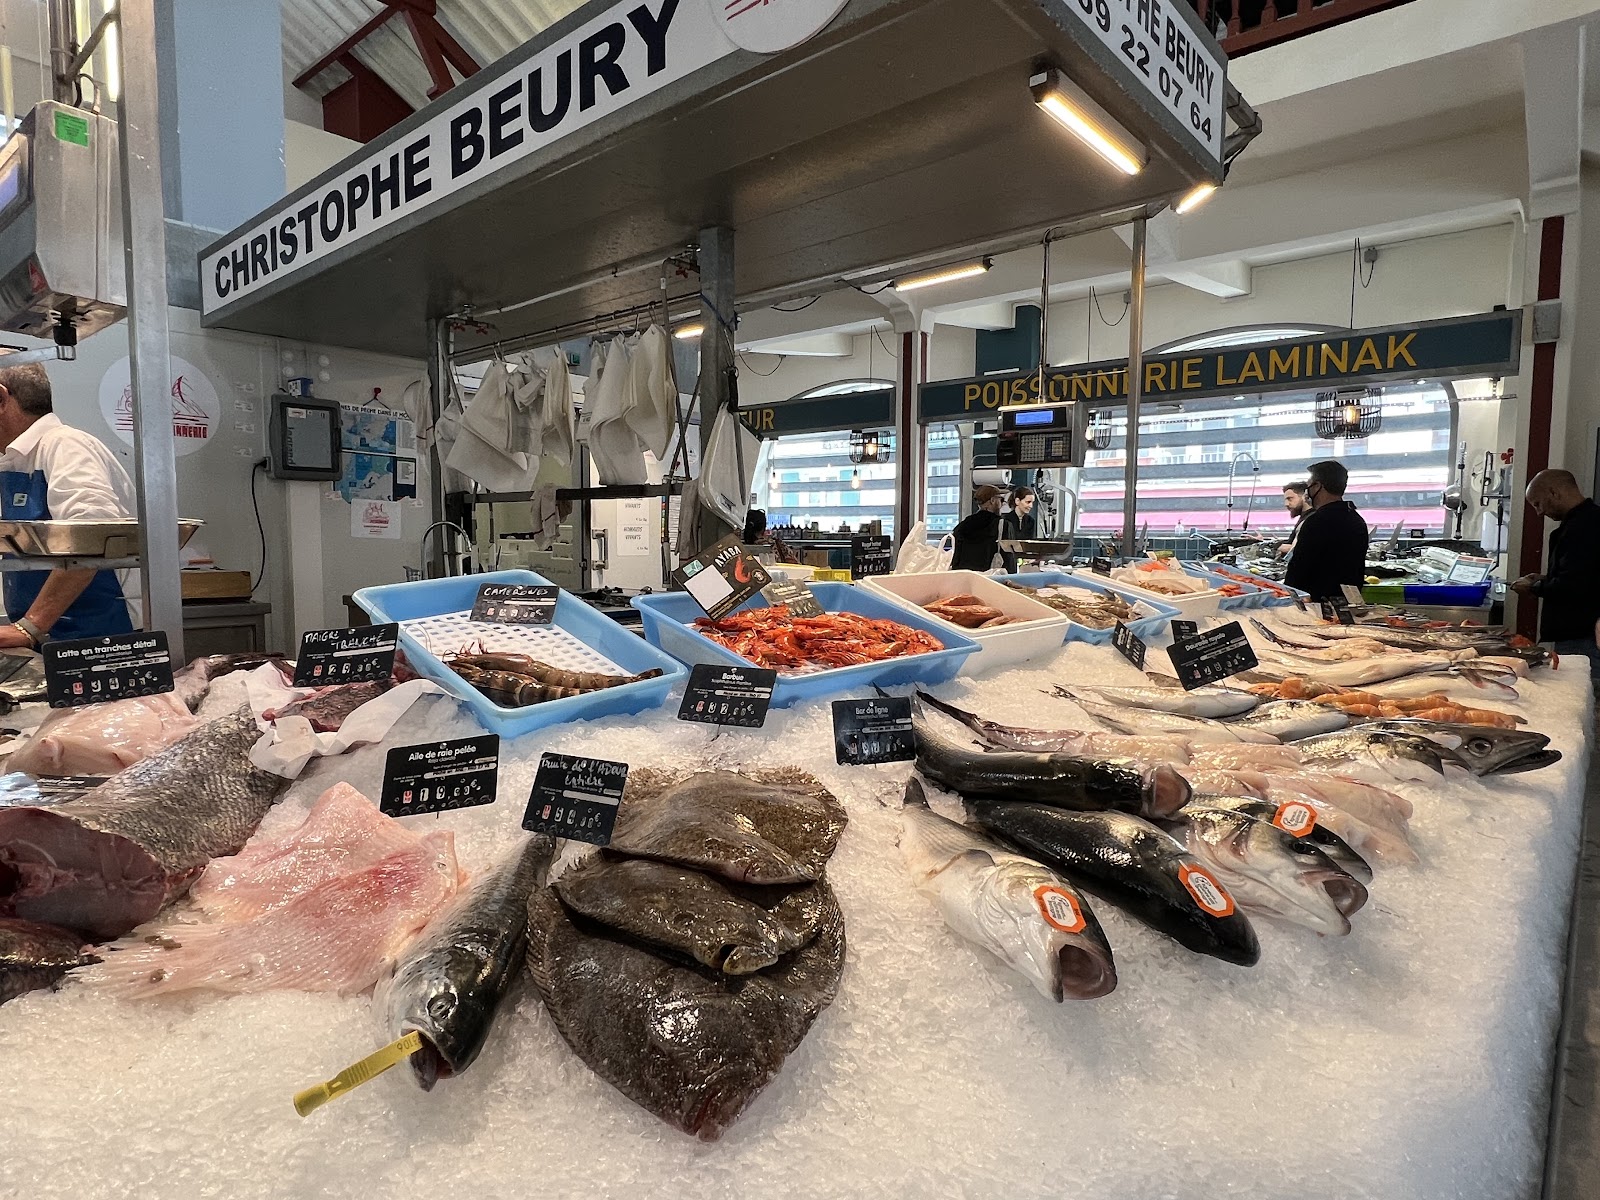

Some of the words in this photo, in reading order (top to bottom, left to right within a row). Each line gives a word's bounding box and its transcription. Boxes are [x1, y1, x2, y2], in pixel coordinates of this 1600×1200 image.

[1165, 15, 1215, 105] BEURY
[1121, 24, 1150, 78] 22
[1159, 66, 1184, 108] 07
[1190, 101, 1212, 143] 64
[215, 134, 432, 298] CHRISTOPHE
[450, 0, 680, 180] BEURY
[1216, 332, 1417, 386] LAMINAK
[713, 545, 743, 568] AYABA
[57, 648, 80, 659] Lotte
[81, 646, 93, 656] en
[94, 642, 132, 654] tranches
[133, 639, 157, 649] détail
[722, 672, 745, 681] Barbue
[855, 707, 865, 715] Bar
[865, 706, 874, 714] de
[874, 705, 889, 714] ligne
[408, 752, 424, 761] Aile
[425, 750, 437, 759] de
[437, 748, 453, 757] raie
[454, 744, 477, 756] pelée
